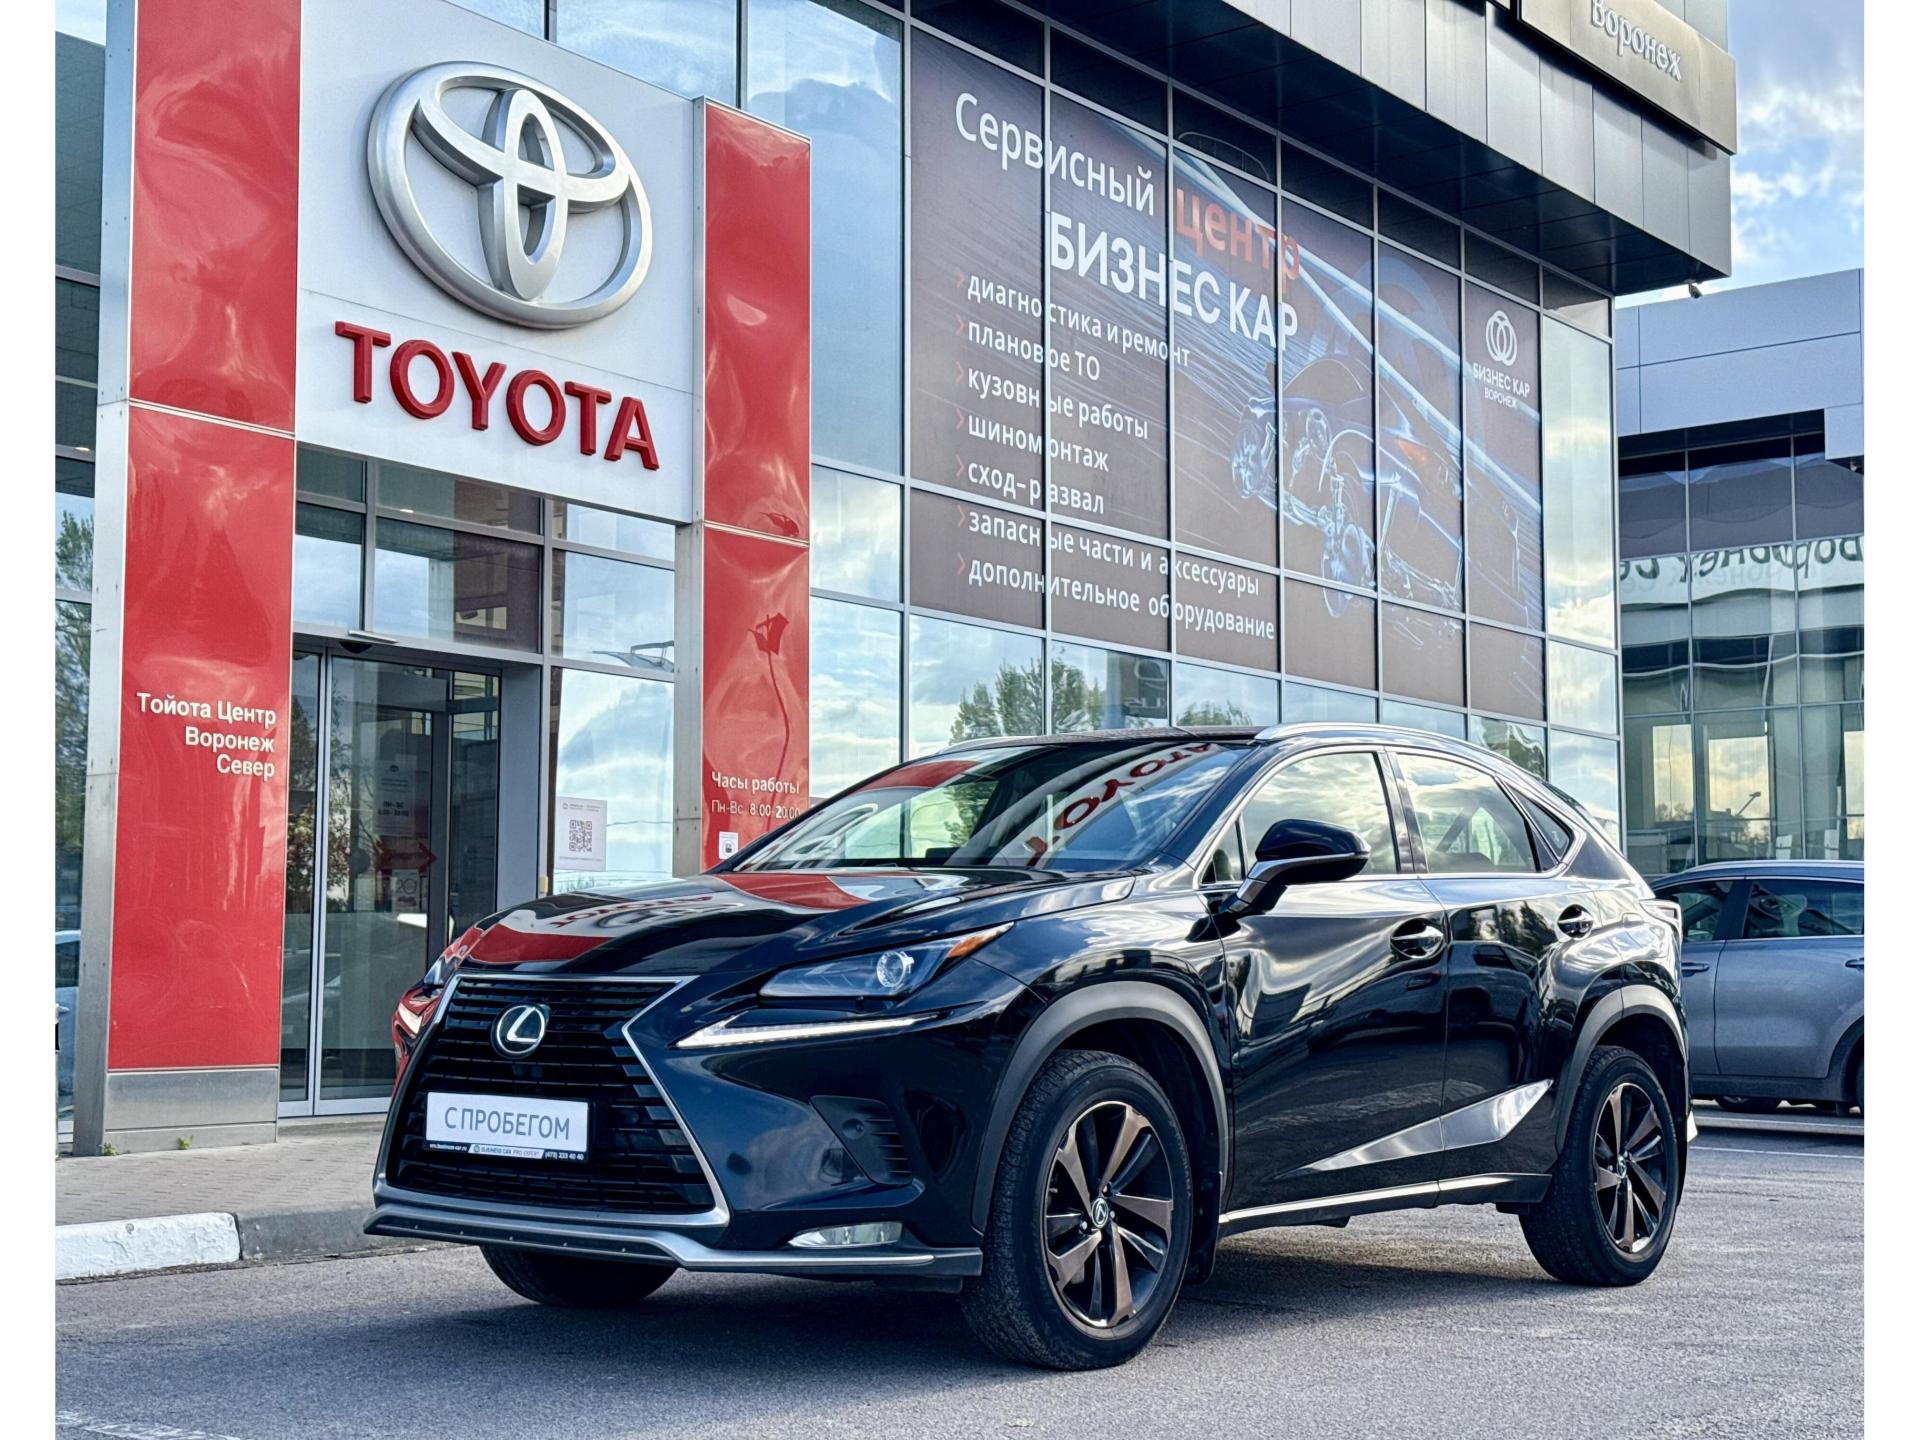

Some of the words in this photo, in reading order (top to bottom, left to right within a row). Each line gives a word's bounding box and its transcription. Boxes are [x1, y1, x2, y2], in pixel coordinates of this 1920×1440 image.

[1591, 0, 1682, 81] Воронеж
[955, 92, 1155, 217] Сервисный
[1176, 187, 1301, 294] центр
[1049, 211, 1221, 325] БИЗНЕС
[1229, 281, 1299, 352] КАР
[967, 275, 1102, 339] диагностика
[1106, 322, 1118, 344] и
[1122, 327, 1190, 367] ремонт
[968, 321, 1071, 373] плановое
[1075, 350, 1101, 381] ТО
[1472, 362, 1512, 391] БИЗНЕС
[1512, 377, 1531, 398] КАР
[334, 320, 660, 471] TOYOTA
[968, 367, 1074, 417] кузовные
[1079, 398, 1149, 441] работы
[1484, 386, 1519, 409] ВОРОНЕЖ
[968, 414, 1110, 473] шиномонтаж
[968, 511, 1075, 553] запасные
[1079, 535, 1135, 568] части
[1140, 550, 1152, 572] и
[1159, 555, 1260, 598] аксессуары
[968, 559, 1141, 612] дополнительное
[1148, 593, 1275, 640] оборудование
[136, 691, 211, 718] Тойота
[217, 699, 277, 729] Центр
[185, 725, 275, 753] Воронеж
[216, 753, 275, 781] Север
[711, 770, 748, 789] Часы
[751, 776, 800, 795] работы
[711, 799, 744, 814] Пн-Вс
[444, 1106, 458, 1129] С
[460, 1108, 570, 1141] ПРОБЕГОМ
